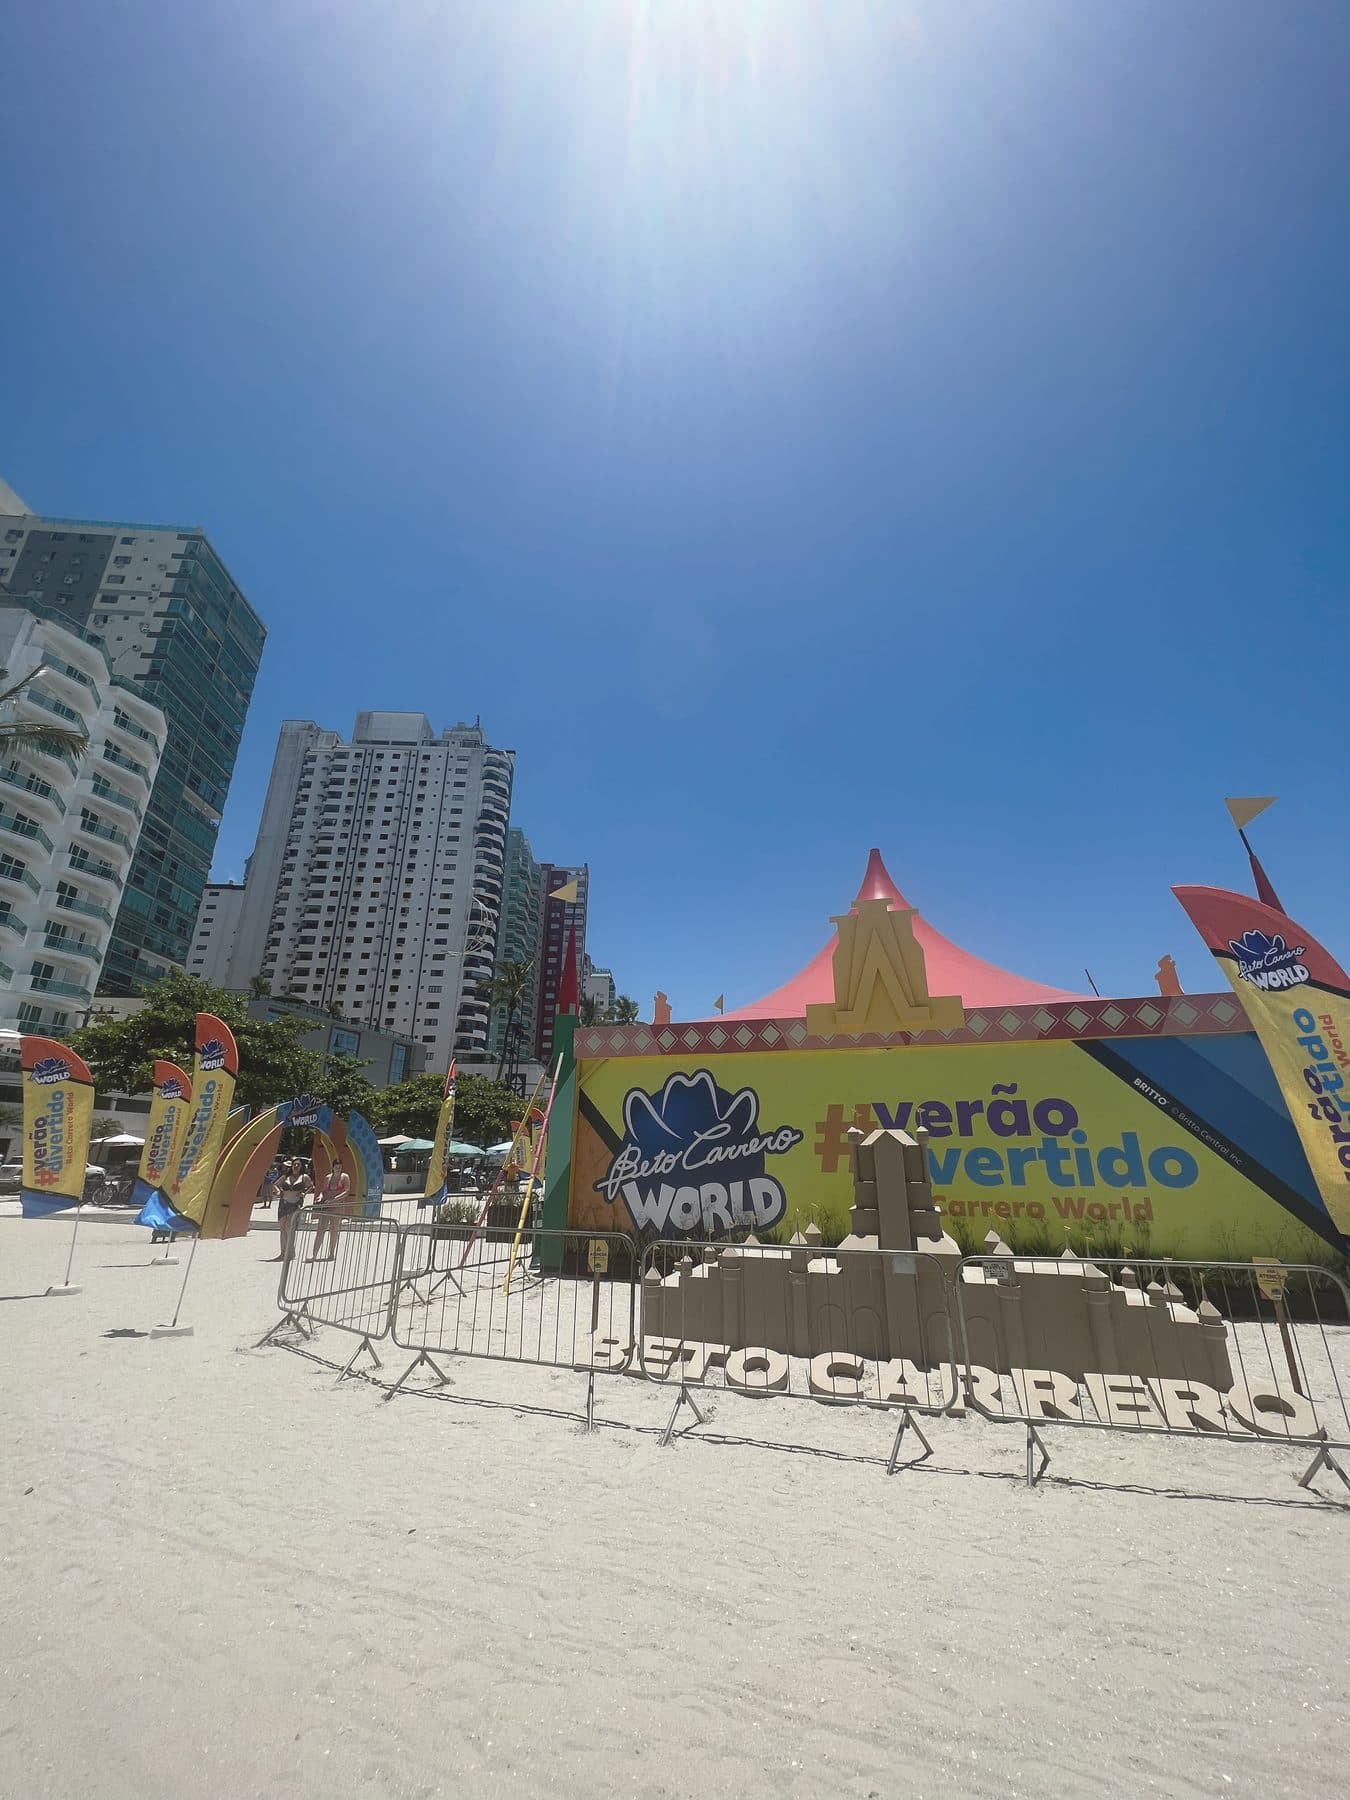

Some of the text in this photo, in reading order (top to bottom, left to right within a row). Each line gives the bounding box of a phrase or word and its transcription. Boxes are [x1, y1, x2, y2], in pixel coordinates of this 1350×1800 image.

[1247, 964, 1310, 991] WORLD
[35, 1071, 71, 1084] WORLD
[1133, 1077, 1168, 1106] BRITTO
[45, 1090, 64, 1173] divertido
[815, 1083, 1080, 1173] #verão
[1179, 1112, 1200, 1132] Britto
[597, 1123, 802, 1201] Beto Carrero
[927, 1131, 1200, 1189] vertido
[622, 1177, 783, 1233] WORLD
[1051, 1197, 1155, 1222] World
[809, 1350, 1327, 1441] CARRERO
